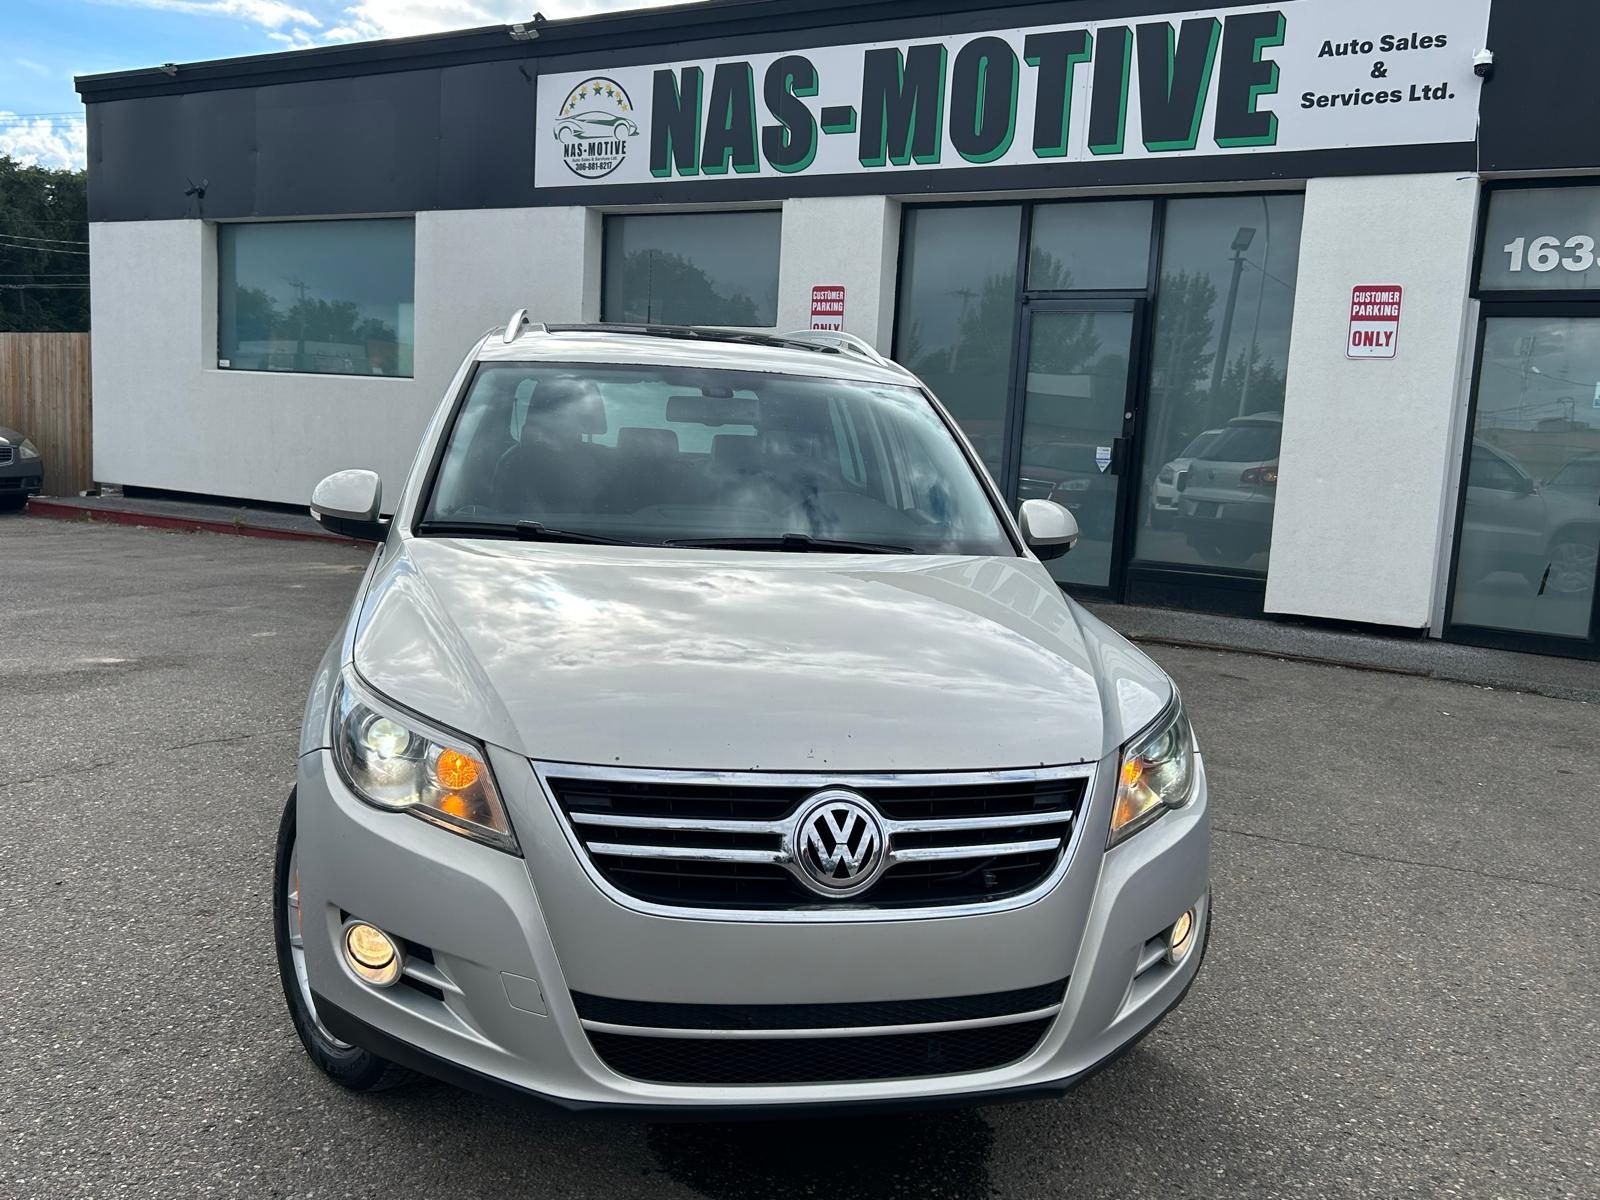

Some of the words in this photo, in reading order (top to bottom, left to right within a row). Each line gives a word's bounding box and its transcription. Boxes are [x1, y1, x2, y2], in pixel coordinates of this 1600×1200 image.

[1317, 39, 1374, 58] Auto
[1379, 32, 1448, 52] Sales
[1370, 61, 1388, 78] &
[649, 10, 1287, 178] NAS-MOTIVE
[1300, 88, 1402, 109] Services
[1408, 82, 1455, 102] Ltd.
[564, 140, 626, 158] NAS-MOTIVE
[1503, 235, 1600, 272] 163
[813, 290, 844, 300] CUSTOMER
[1353, 291, 1400, 303] CUSTOMER
[812, 302, 843, 312] PARKING
[1352, 304, 1399, 316] PARKING
[1352, 330, 1393, 347] ONLY
